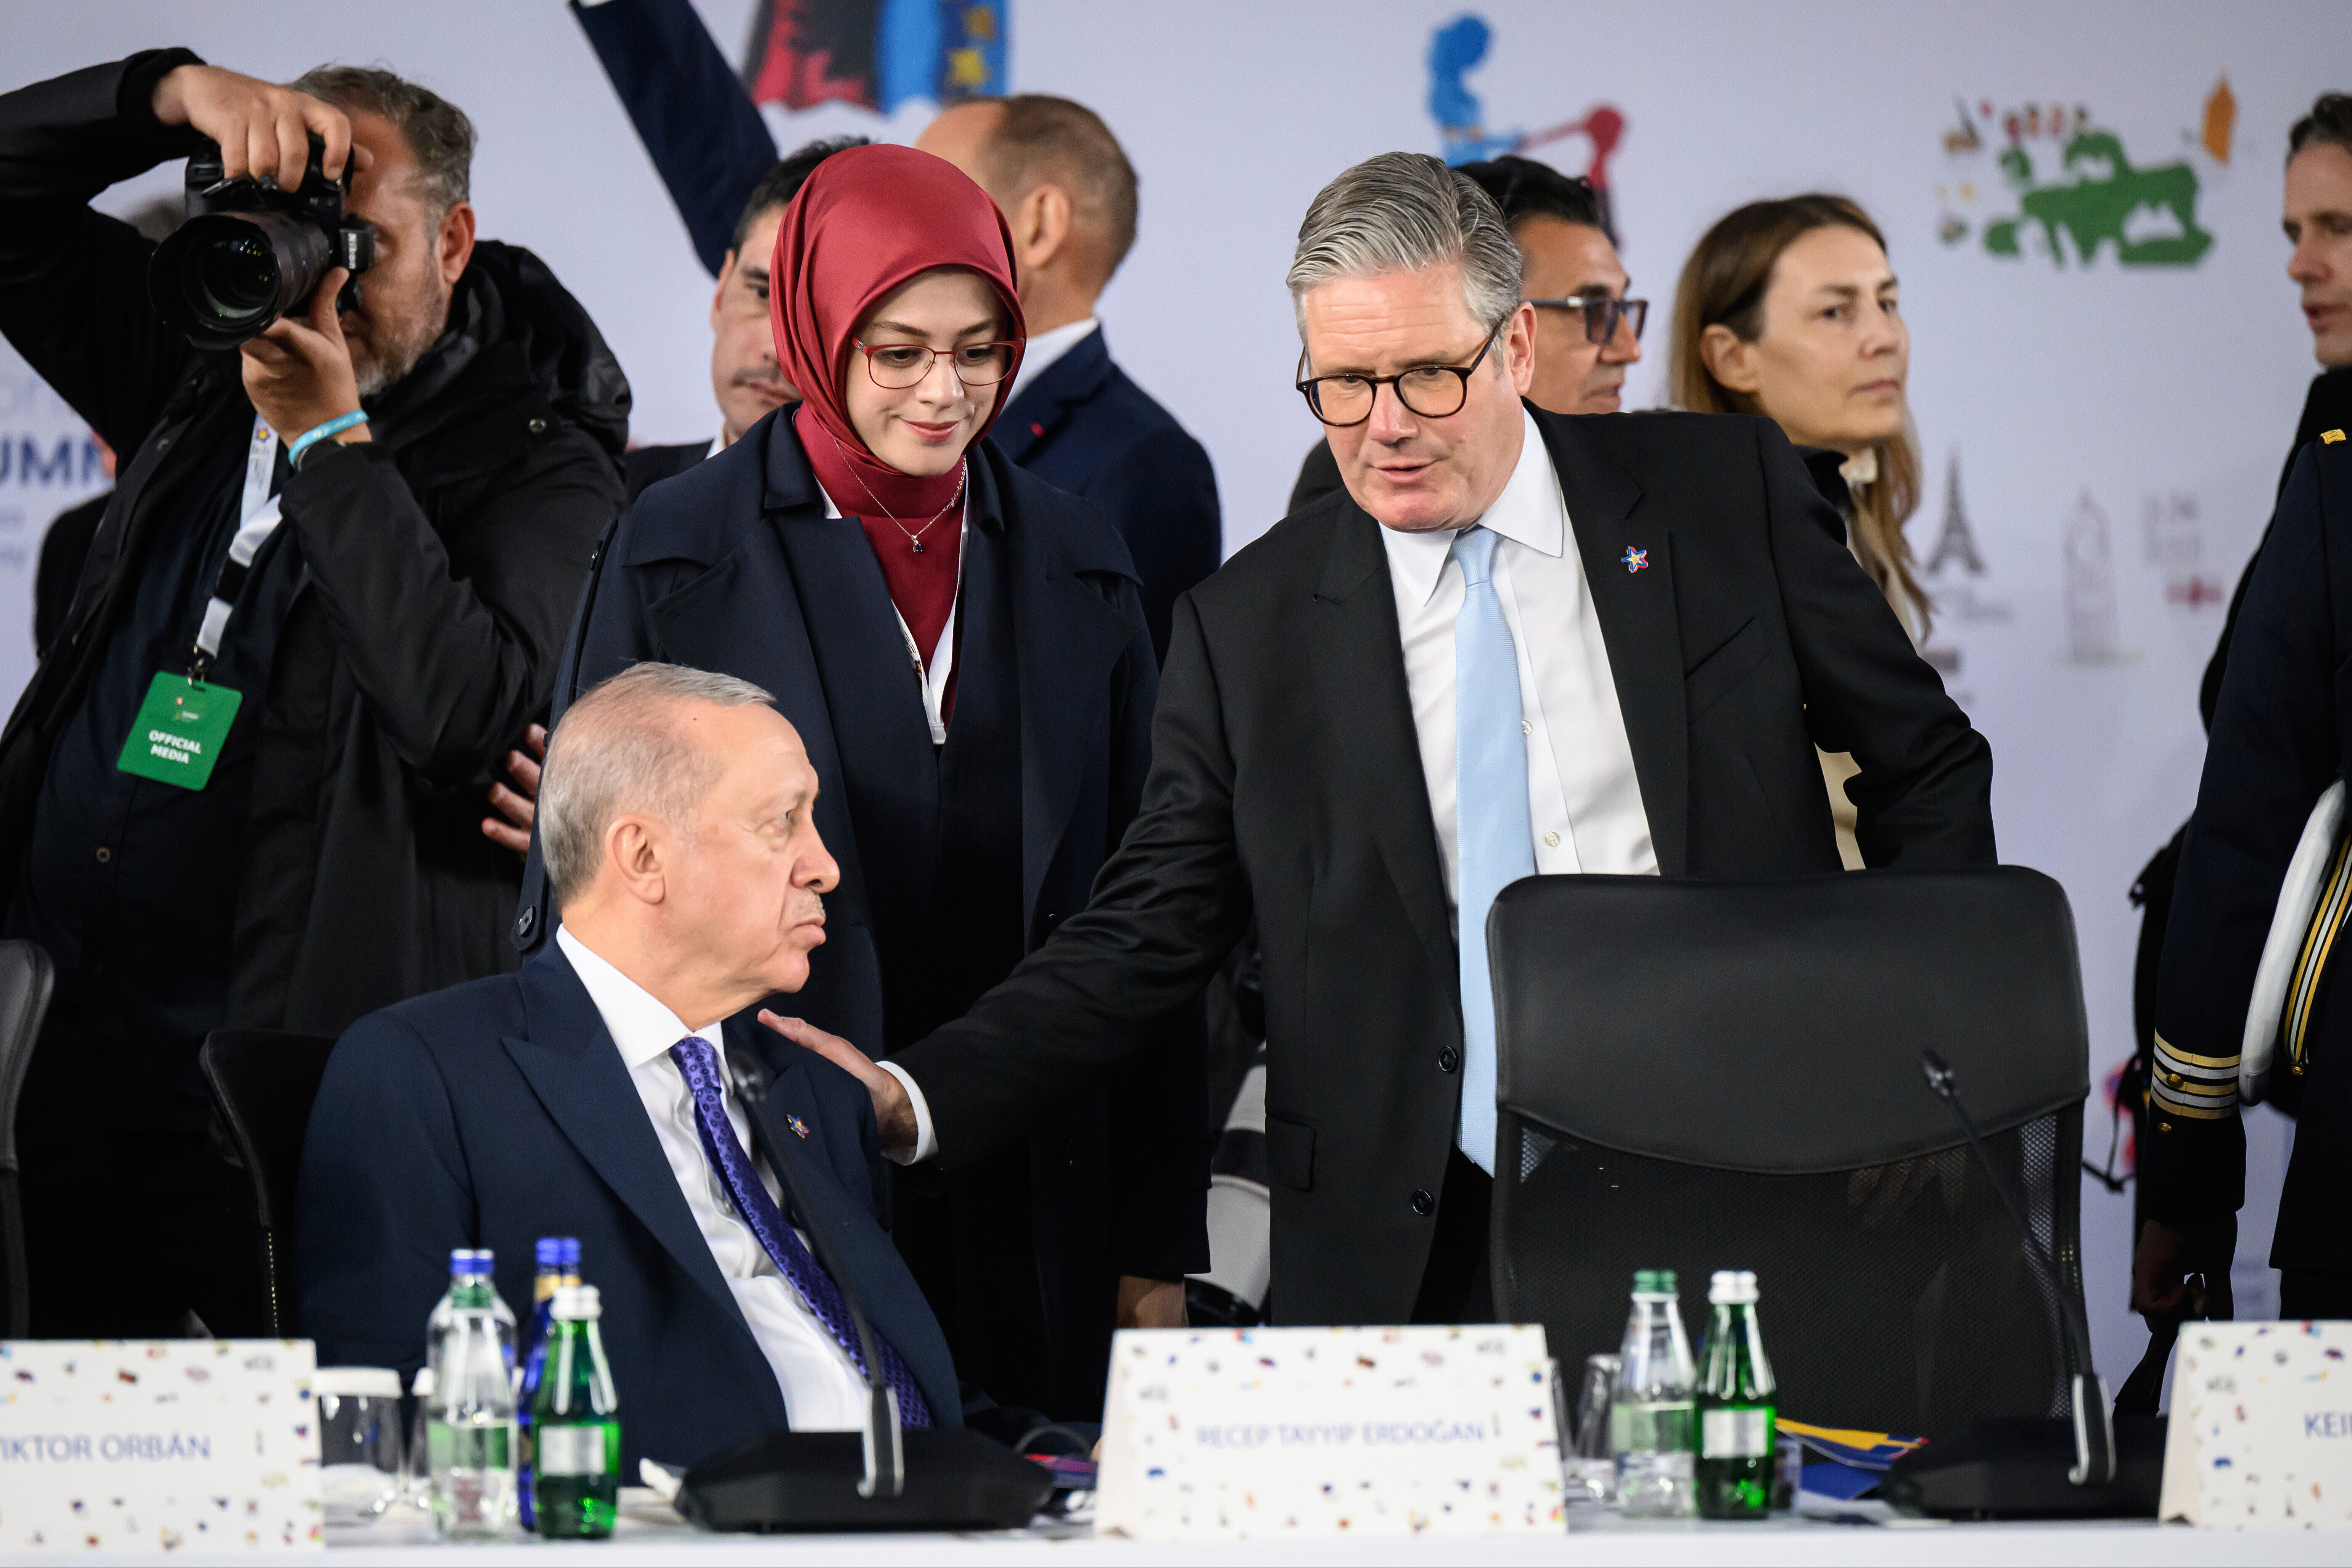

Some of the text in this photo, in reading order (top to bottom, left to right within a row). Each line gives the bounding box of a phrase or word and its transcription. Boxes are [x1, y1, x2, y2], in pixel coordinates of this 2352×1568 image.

[149, 730, 201, 754] OFFICIAL
[150, 744, 190, 764] MEDIA
[1196, 1424, 1270, 1448] RECEP
[2304, 1411, 2352, 1438] KEI
[0, 1429, 211, 1463] IKTOR ORBÁN
